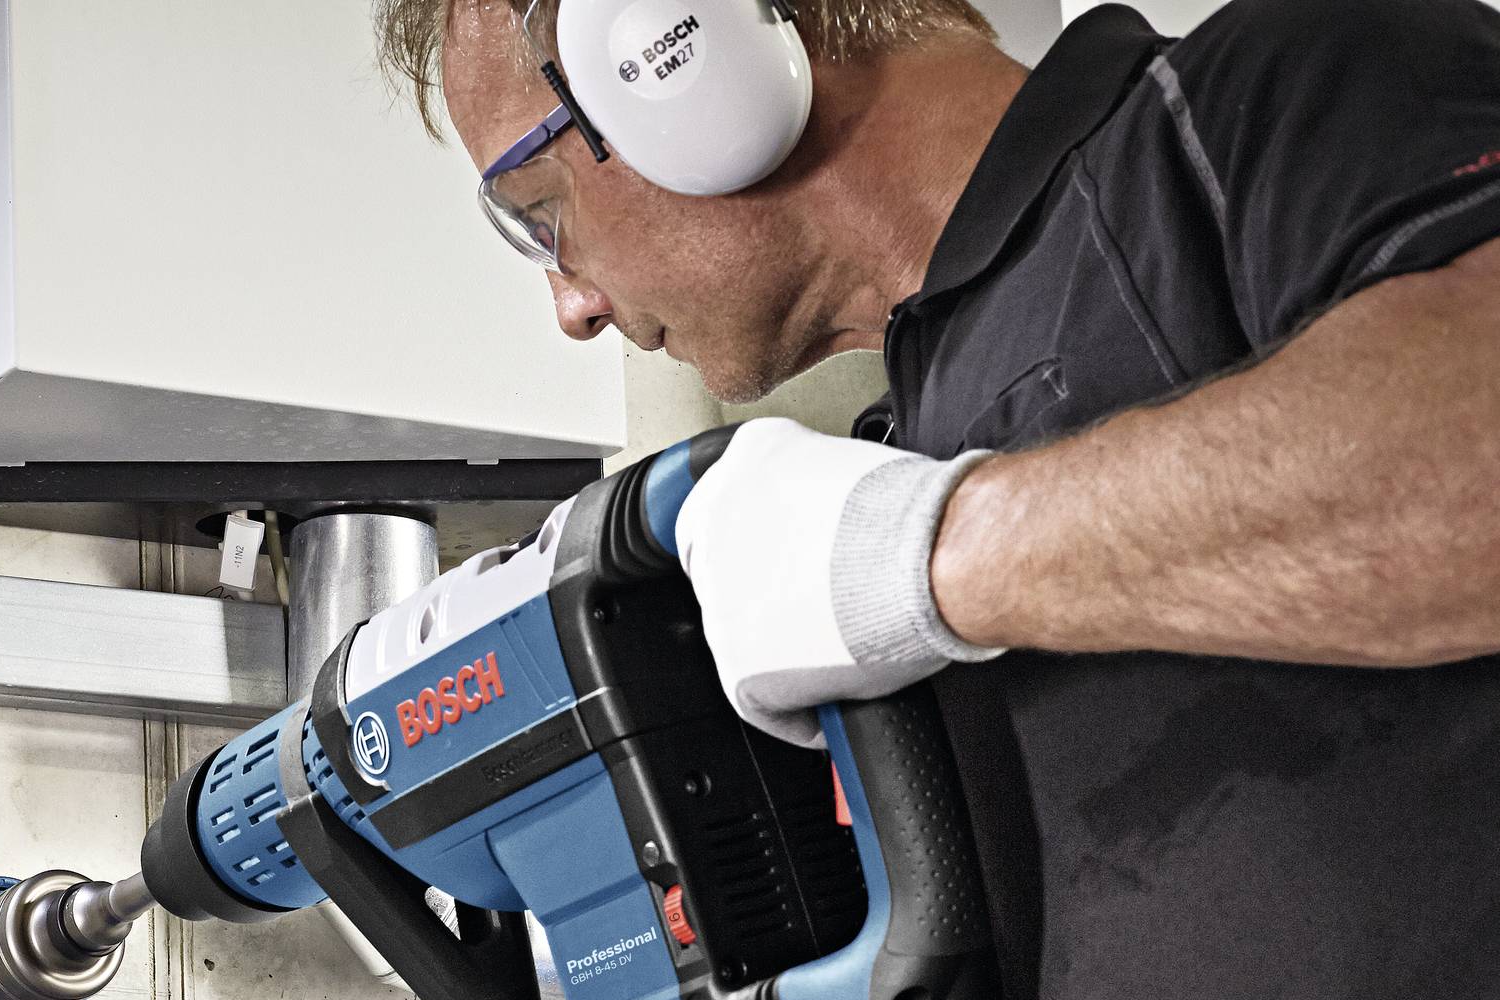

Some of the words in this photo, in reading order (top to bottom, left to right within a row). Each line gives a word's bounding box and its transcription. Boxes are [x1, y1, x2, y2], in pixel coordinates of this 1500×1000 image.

[642, 15, 700, 64] BOSCH
[654, 42, 694, 81] EM27
[396, 651, 505, 748] BOSCH
[566, 926, 658, 974] Professional
[571, 970, 593, 986] GBH
[595, 960, 617, 976] 8-45
[619, 953, 633, 966] DV
